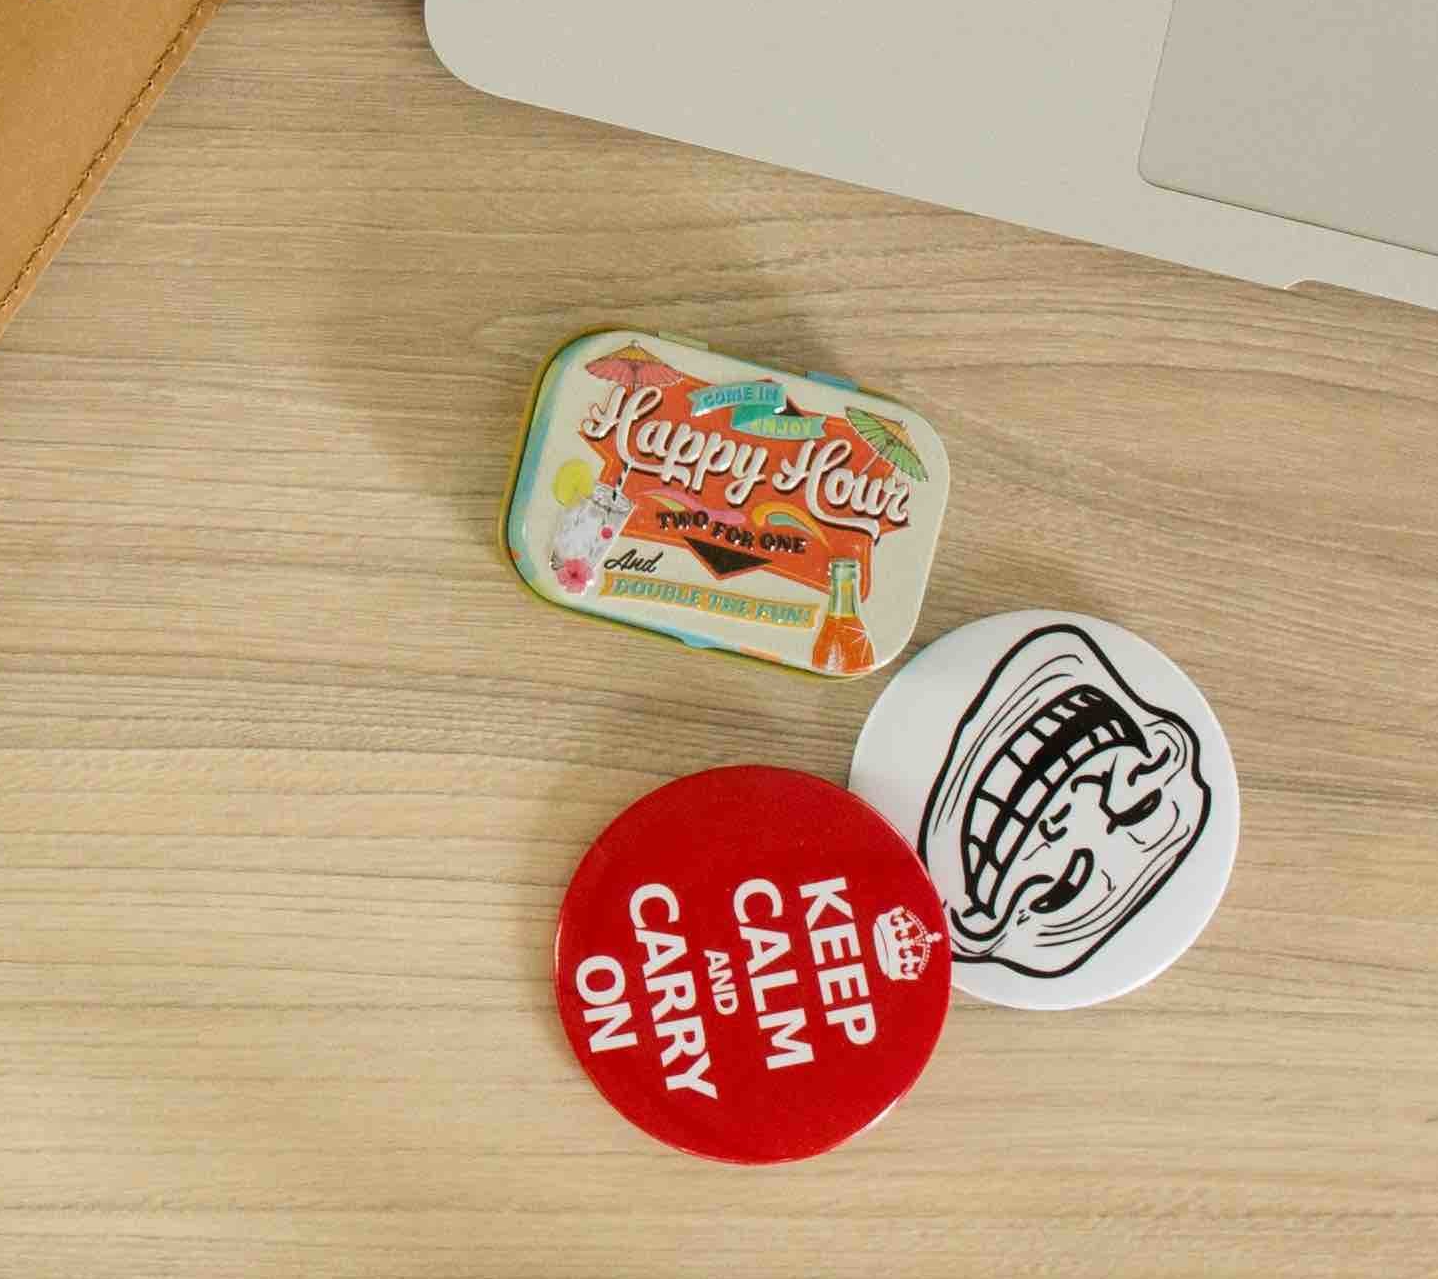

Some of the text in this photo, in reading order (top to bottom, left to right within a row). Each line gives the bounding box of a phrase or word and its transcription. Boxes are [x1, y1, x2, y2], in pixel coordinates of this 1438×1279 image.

[702, 385, 779, 407] COME IN
[581, 385, 912, 542] Happy Hour
[604, 549, 664, 573] And
[656, 511, 807, 554] TWO FOR ONE
[612, 579, 813, 623] DOUBLE THE FUN!
[630, 884, 717, 1100] CARRY
[705, 951, 740, 1016] AND
[733, 878, 814, 1070] CALM
[801, 877, 876, 1047] KEEP
[576, 955, 636, 1054] ON
